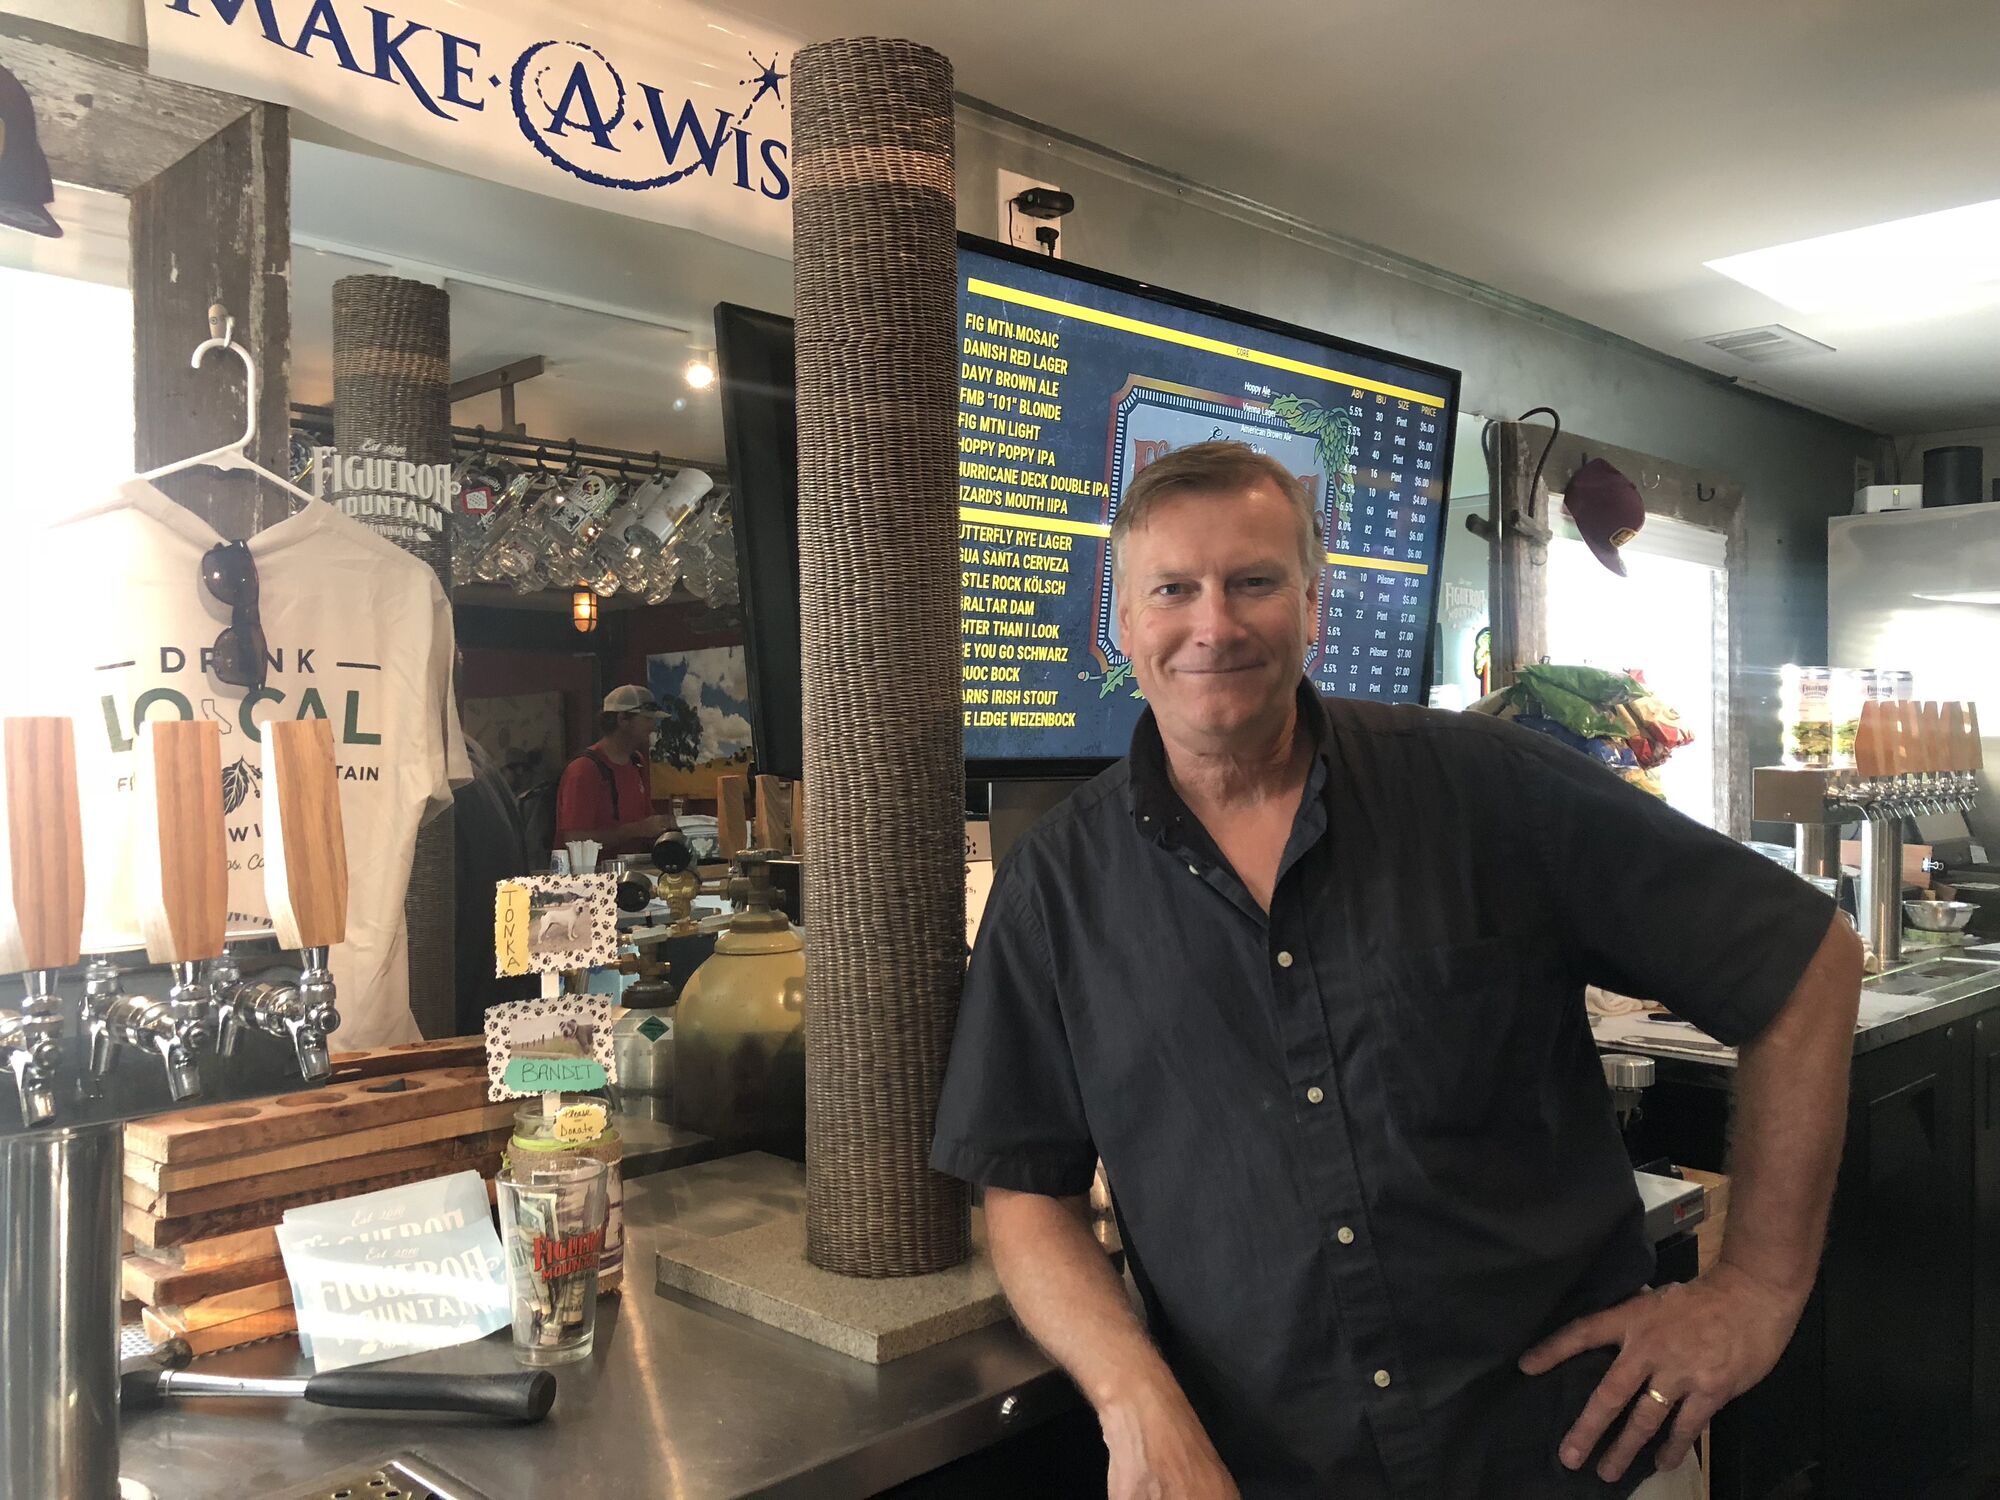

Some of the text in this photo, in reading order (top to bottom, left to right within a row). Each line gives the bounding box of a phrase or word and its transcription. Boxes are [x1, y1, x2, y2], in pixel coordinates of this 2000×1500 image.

[547, 61, 621, 152] A
[637, 83, 791, 200] WIS
[966, 313, 1059, 348] FIG MTN MOSAIC
[964, 338, 1068, 375] DANISH RED LAGER
[1236, 348, 1250, 358] CORE
[962, 363, 1059, 398] DAVY BROWN ALE
[1244, 381, 1272, 396] Hoppy Ale
[960, 386, 1062, 420] FMB "101" BLONDE
[1242, 402, 1276, 418] Vienna Lager
[1351, 388, 1437, 417] ABV IBU SIZE PRICE
[958, 412, 1041, 441] FIG MTN LIGHT
[1376, 412, 1384, 422] 30
[1396, 416, 1408, 427] Pint
[1240, 424, 1266, 436] American
[1266, 429, 1282, 440] Brown
[1283, 432, 1292, 442] Ale
[1374, 430, 1382, 441] 23
[1394, 435, 1406, 446] Pint
[958, 437, 1056, 466] HOPPY POPPY IPA
[1372, 450, 1380, 460] 40
[1392, 454, 1404, 464] Pint
[313, 446, 461, 513] FIGUEROA
[1370, 468, 1378, 478] 16
[1390, 472, 1402, 482] Pint
[1020, 471, 1048, 489] DECK
[1051, 475, 1090, 496] DOUBLE
[1093, 482, 1109, 498] IPA
[960, 485, 1068, 514] IZARD'S MOUTH IIPA
[1368, 488, 1376, 498] 10
[1388, 490, 1400, 502] Pint
[1366, 506, 1374, 516] 60
[1387, 509, 1398, 520] Pint
[1364, 525, 1372, 534] 82
[1385, 528, 1396, 538] Pint
[1016, 530, 1037, 547] RYE
[1039, 534, 1072, 551] LAGER
[1363, 543, 1370, 552] 75
[1384, 546, 1394, 556] Pint
[982, 550, 1020, 568] SANTA
[1023, 554, 1069, 573] CERVEZA
[992, 576, 1022, 592] ROCK
[1024, 576, 1066, 595] KÖLSCH
[1332, 570, 1420, 588] 4.8% 10 Pilsner $7.00
[1330, 588, 1418, 605] 4.8% 9 Pint $5.00
[1010, 600, 1034, 616] DAM
[1328, 607, 1416, 623] 5.2% 22 Pint $7.00
[993, 621, 1023, 638] THAN
[1026, 624, 1029, 637] I
[1032, 624, 1060, 639] LOOK
[1327, 626, 1414, 641] 5.6% Pint $7.00
[974, 644, 996, 659] YOU
[999, 645, 1014, 660] GO
[1018, 646, 1068, 662] SCHWARZ
[1325, 644, 1412, 658] 6.0% 25 Pilsner $7.00
[160, 646, 316, 674] DNK
[990, 667, 1020, 682] BOCK
[1323, 664, 1410, 676] 5.5% 22 Pint $7.00
[1322, 682, 1408, 694] 8.5% 18 Pint $7.00
[992, 690, 1021, 704] IRISH
[1023, 690, 1058, 706] STOUT
[974, 712, 1008, 727] LEDGE
[1010, 712, 1076, 727] WEIZENBOCK
[501, 890, 521, 968] TONKA
[521, 1063, 593, 1083] BANDIT
[560, 1122, 593, 1137] Donate
